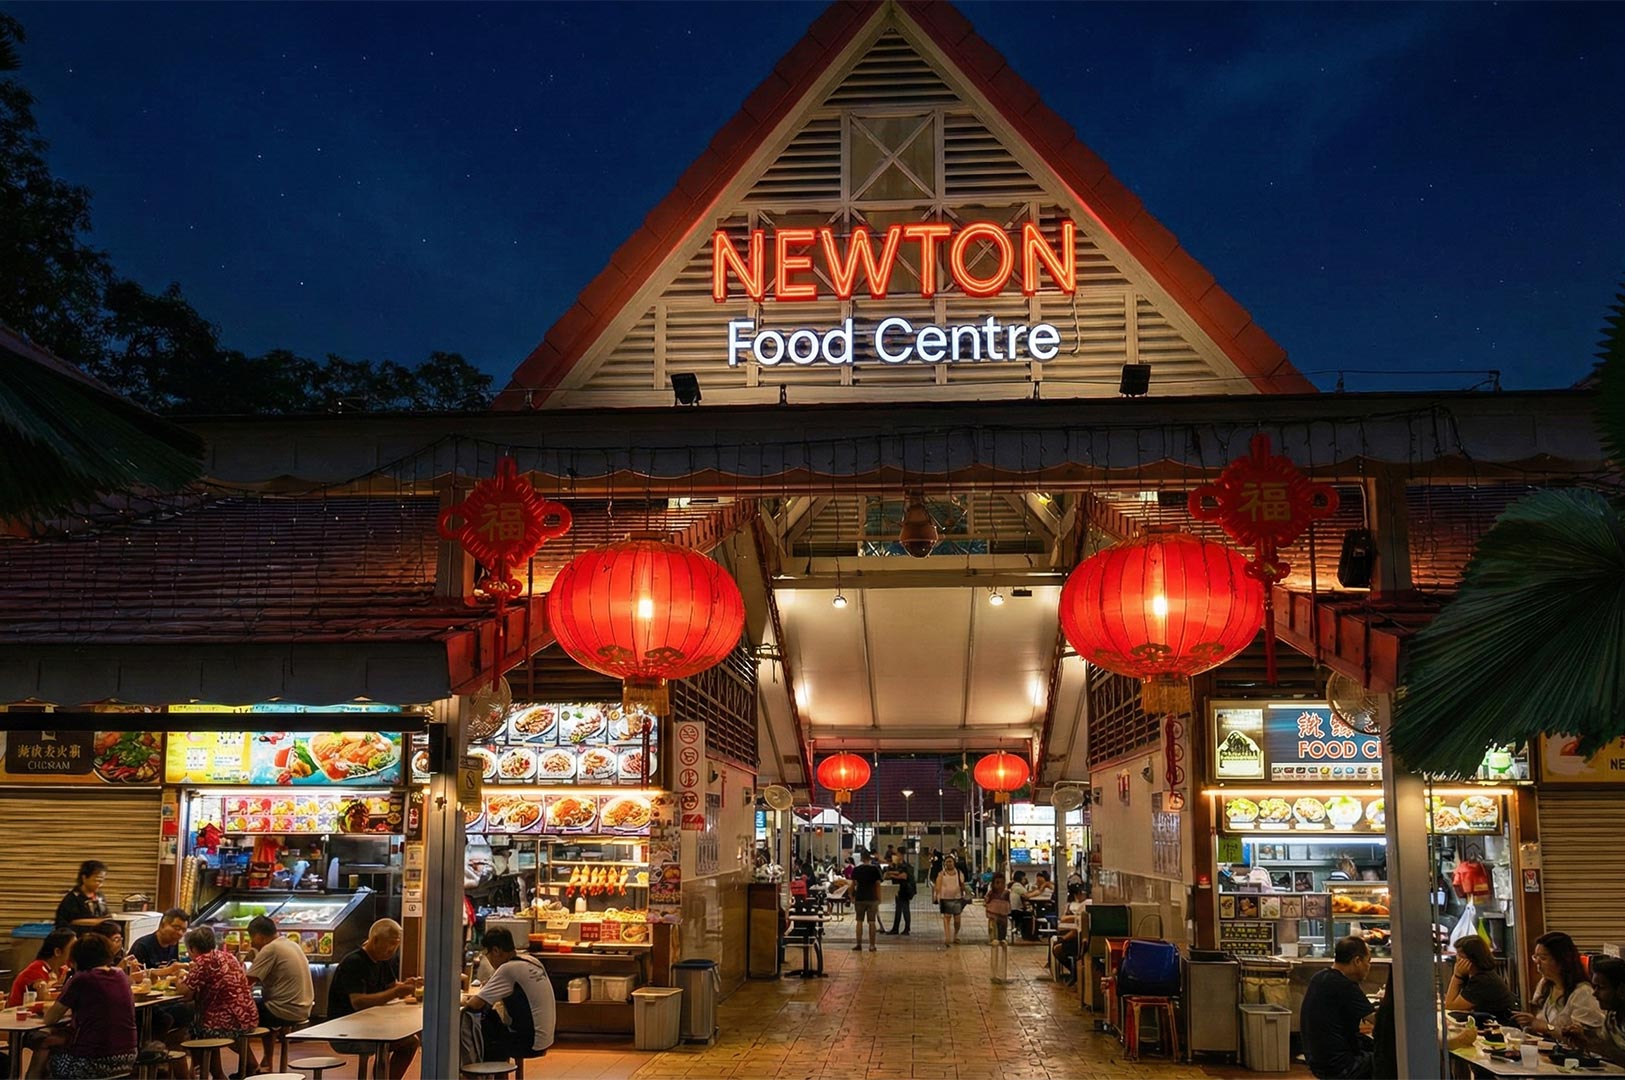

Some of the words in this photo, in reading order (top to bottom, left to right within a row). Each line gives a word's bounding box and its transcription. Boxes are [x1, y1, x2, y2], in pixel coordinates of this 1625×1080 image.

[712, 221, 1077, 302] NEWTON
[728, 317, 853, 367] Food
[873, 315, 1061, 364] Centre
[478, 502, 525, 542] 福
[1237, 482, 1291, 522] 福
[1298, 740, 1358, 759] FOOD
